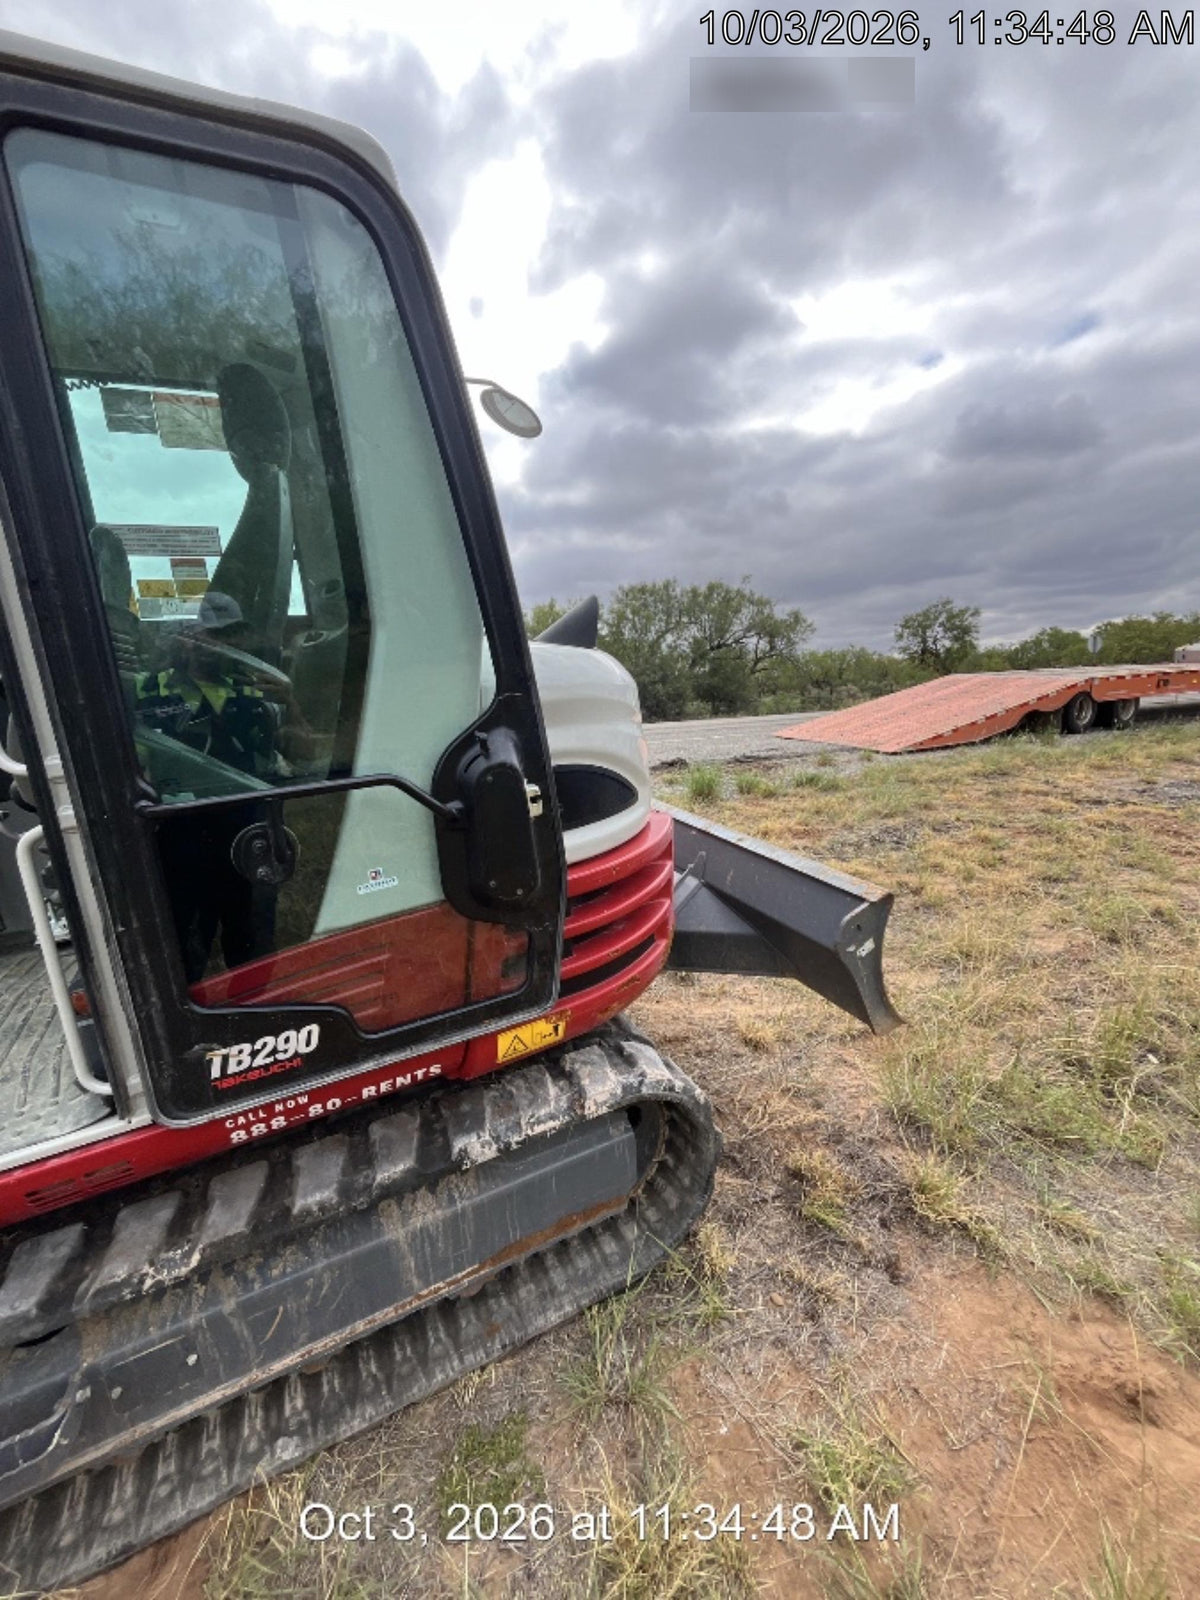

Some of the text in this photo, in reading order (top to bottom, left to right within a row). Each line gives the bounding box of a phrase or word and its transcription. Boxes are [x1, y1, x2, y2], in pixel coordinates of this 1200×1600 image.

[206, 1023, 320, 1080] TB290
[225, 1094, 309, 1129] CALL NOW
